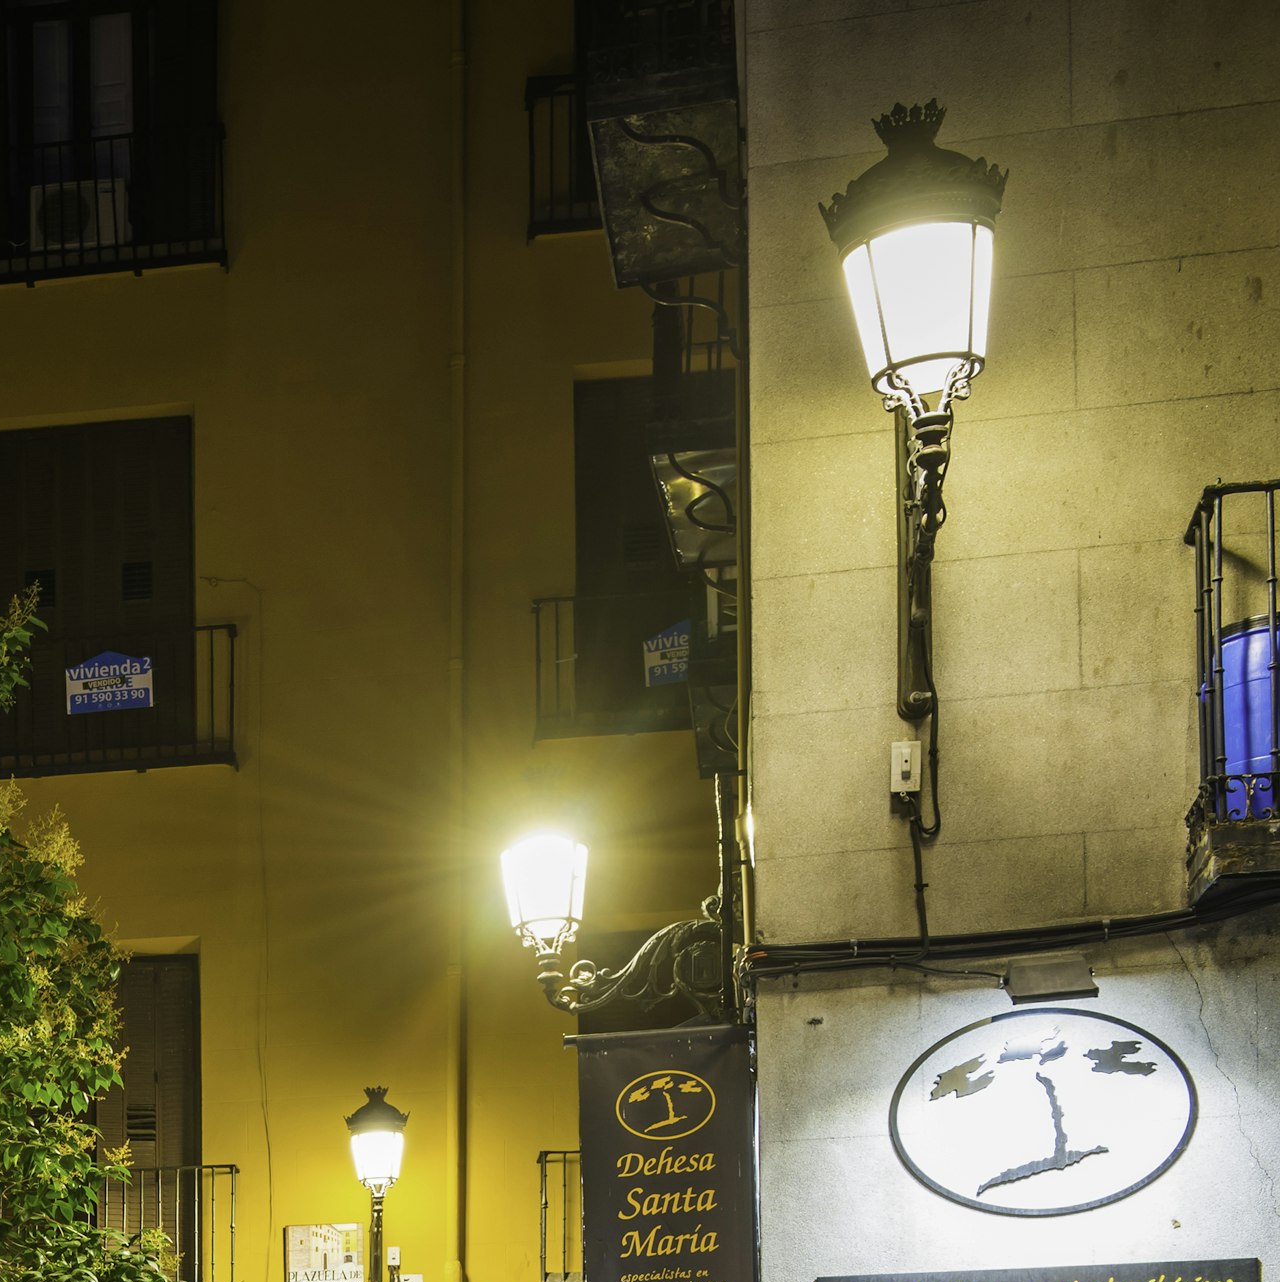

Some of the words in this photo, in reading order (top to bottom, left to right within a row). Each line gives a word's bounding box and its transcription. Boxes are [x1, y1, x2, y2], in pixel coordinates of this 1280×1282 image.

[654, 666, 667, 676] 91
[88, 677, 121, 689] VENDIDO
[75, 695, 88, 705] 91
[92, 692, 112, 703] 590
[115, 690, 128, 701] 33
[131, 689, 145, 699] 90
[616, 1146, 715, 1178] Dehesa
[618, 1187, 718, 1220] Santa
[620, 1225, 719, 1259] María
[349, 1270, 362, 1279] DE
[696, 1269, 708, 1278] en
